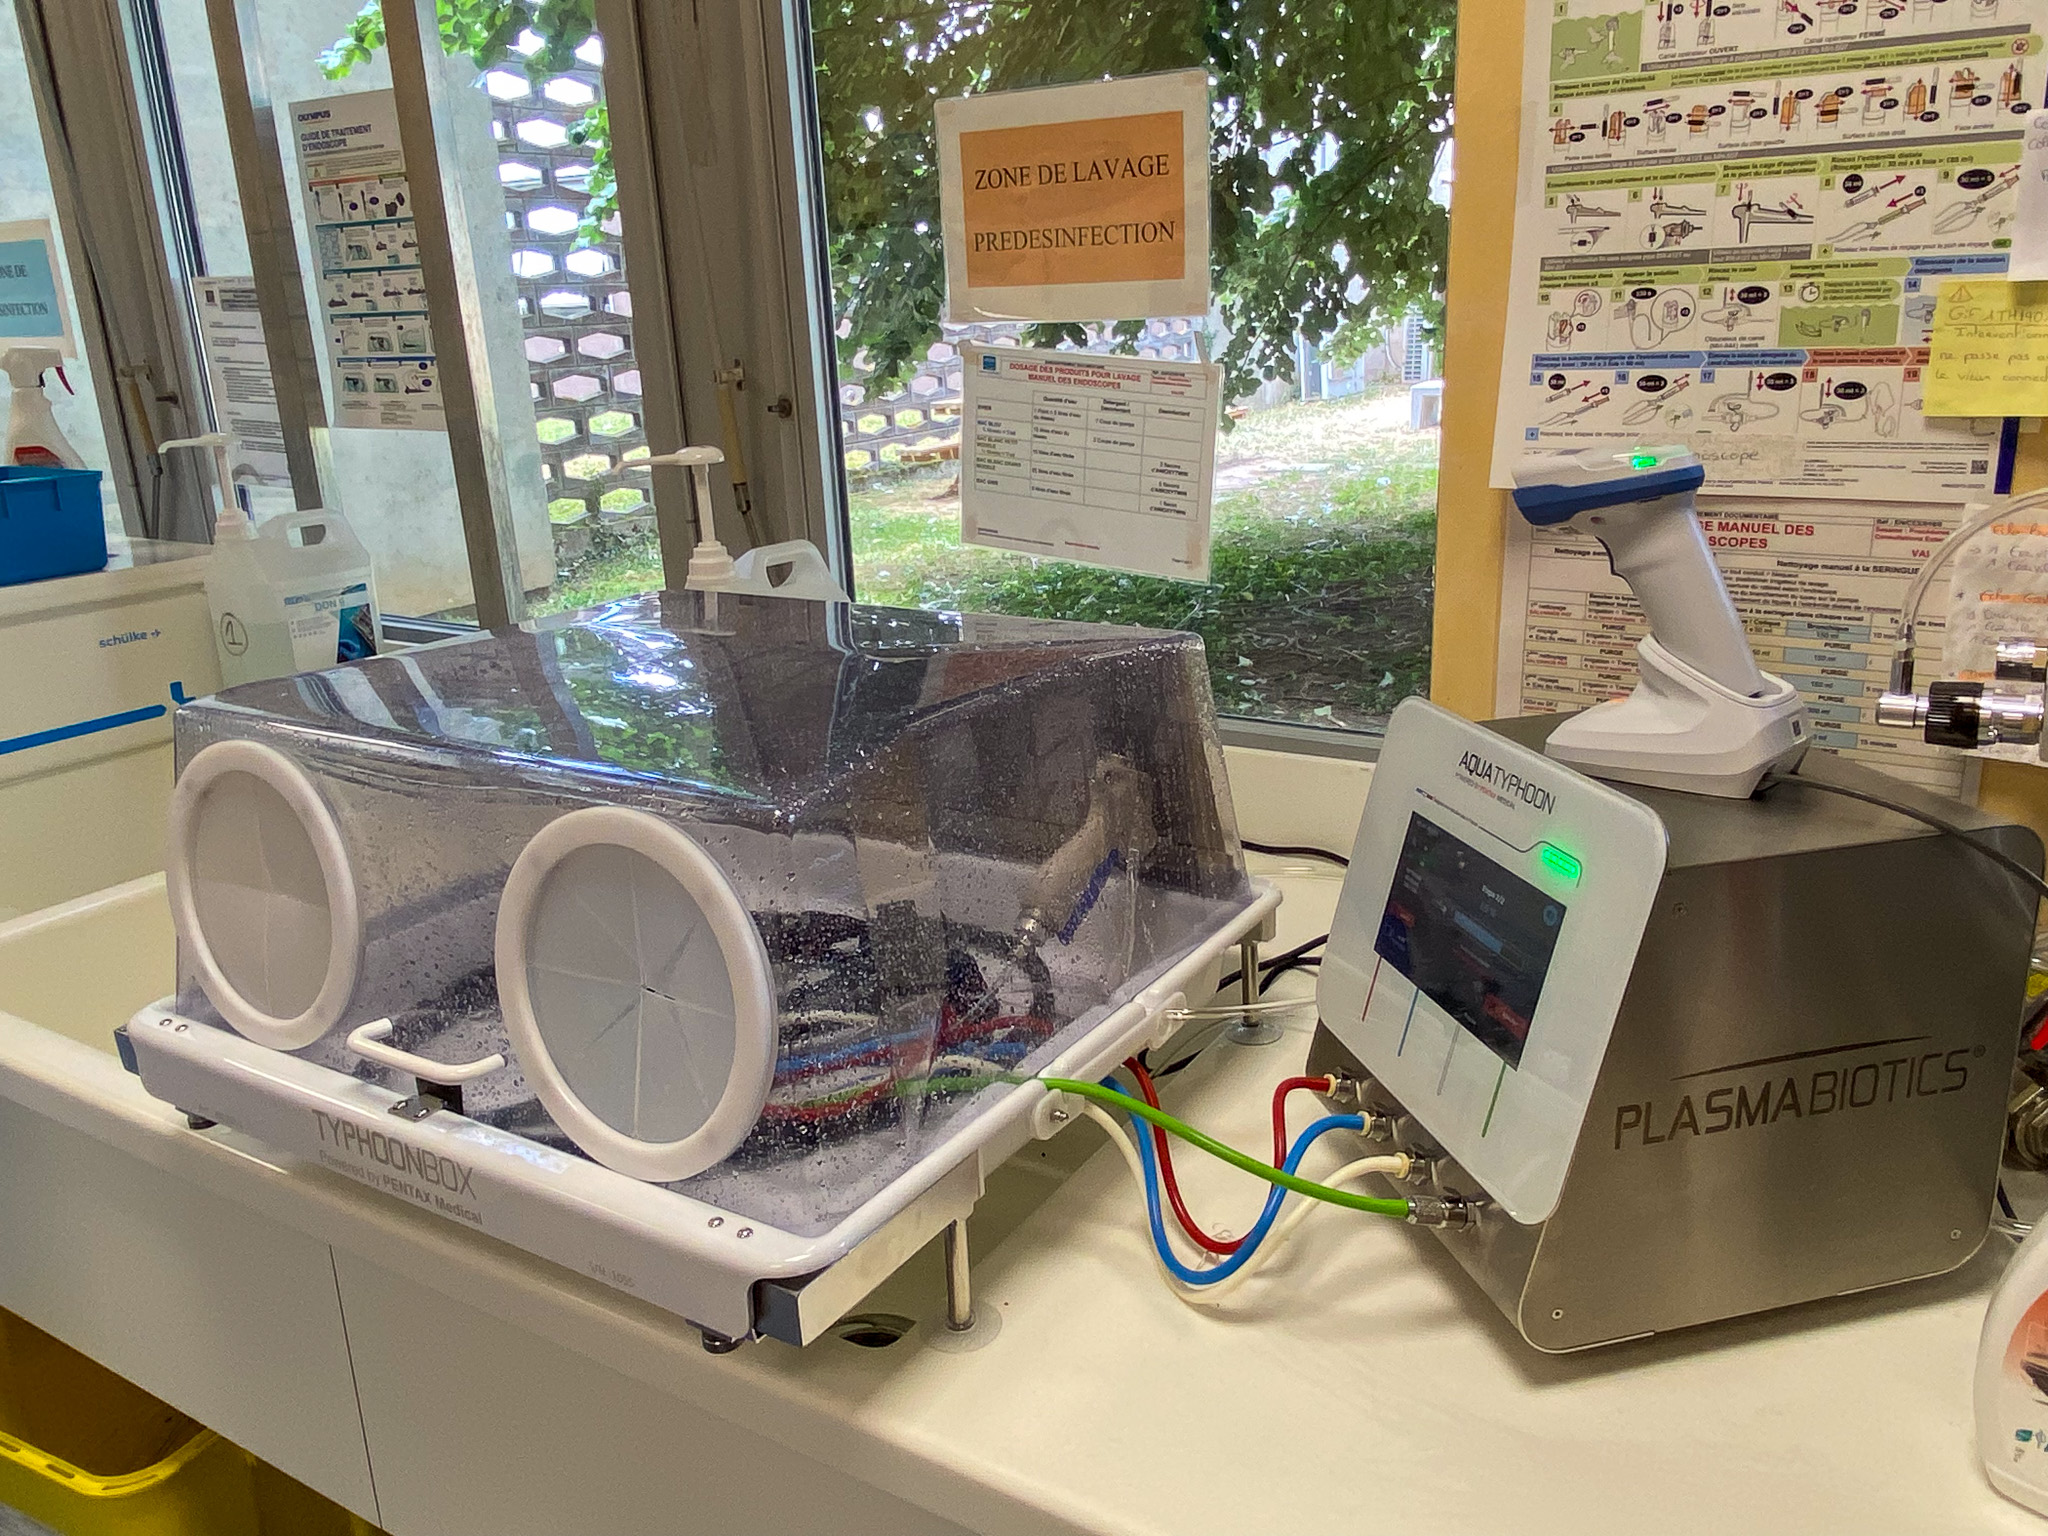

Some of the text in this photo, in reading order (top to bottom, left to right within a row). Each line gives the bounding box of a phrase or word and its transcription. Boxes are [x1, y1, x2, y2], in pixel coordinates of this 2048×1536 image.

[297, 109, 332, 122] OLYMPUS
[974, 153, 1170, 190] ZONE DE LAVAGE
[973, 220, 1176, 252] PREDESINFECTION
[1009, 362, 1038, 373] DOSAGE
[1039, 364, 1054, 374] DES
[1054, 366, 1090, 377] PRODUITS
[1091, 370, 1112, 380] POUR
[1112, 372, 1142, 383] LAVAGE
[1057, 376, 1072, 385] DES
[1073, 377, 1122, 389] ENDOSCOPES
[1718, 521, 1780, 535] MANUEL
[1784, 523, 1815, 536] DES
[1554, 547, 1591, 557] Nettoyage
[1708, 536, 1769, 549] SCOPES
[1776, 560, 1819, 571] Nettoyage
[98, 629, 149, 649] schülke
[1458, 750, 1557, 815] AQUATYPHOON
[311, 1108, 478, 1200] TYPHOONBOX
[319, 1149, 366, 1180] Powered
[382, 1173, 432, 1206] PENTAX
[434, 1194, 484, 1226] Medical
